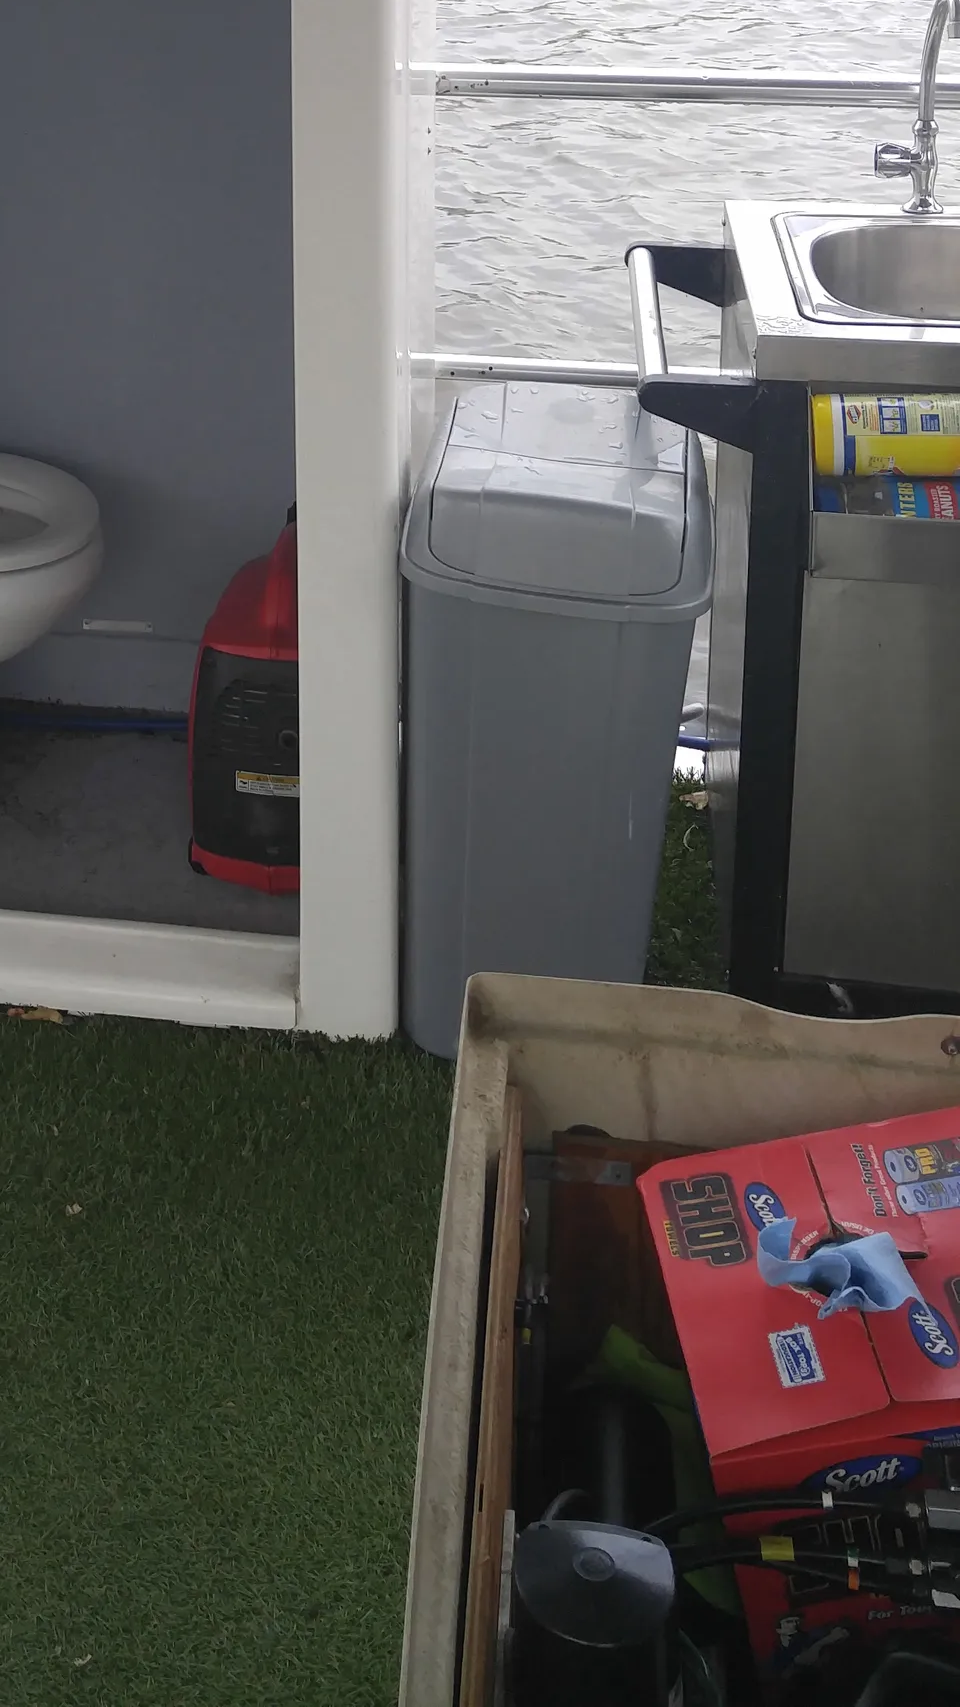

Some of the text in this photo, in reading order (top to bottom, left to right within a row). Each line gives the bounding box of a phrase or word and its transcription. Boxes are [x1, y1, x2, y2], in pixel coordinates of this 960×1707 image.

[915, 1147, 937, 1175] PRO
[851, 1144, 887, 1217] Don't Forget!
[664, 1220, 680, 1256] TOWELS
[671, 1176, 746, 1266] SHOP
[785, 1336, 801, 1353] BOX
[912, 1311, 954, 1356] Scott
[780, 1341, 798, 1376] EDUCATION
[826, 1457, 901, 1492] Scott
